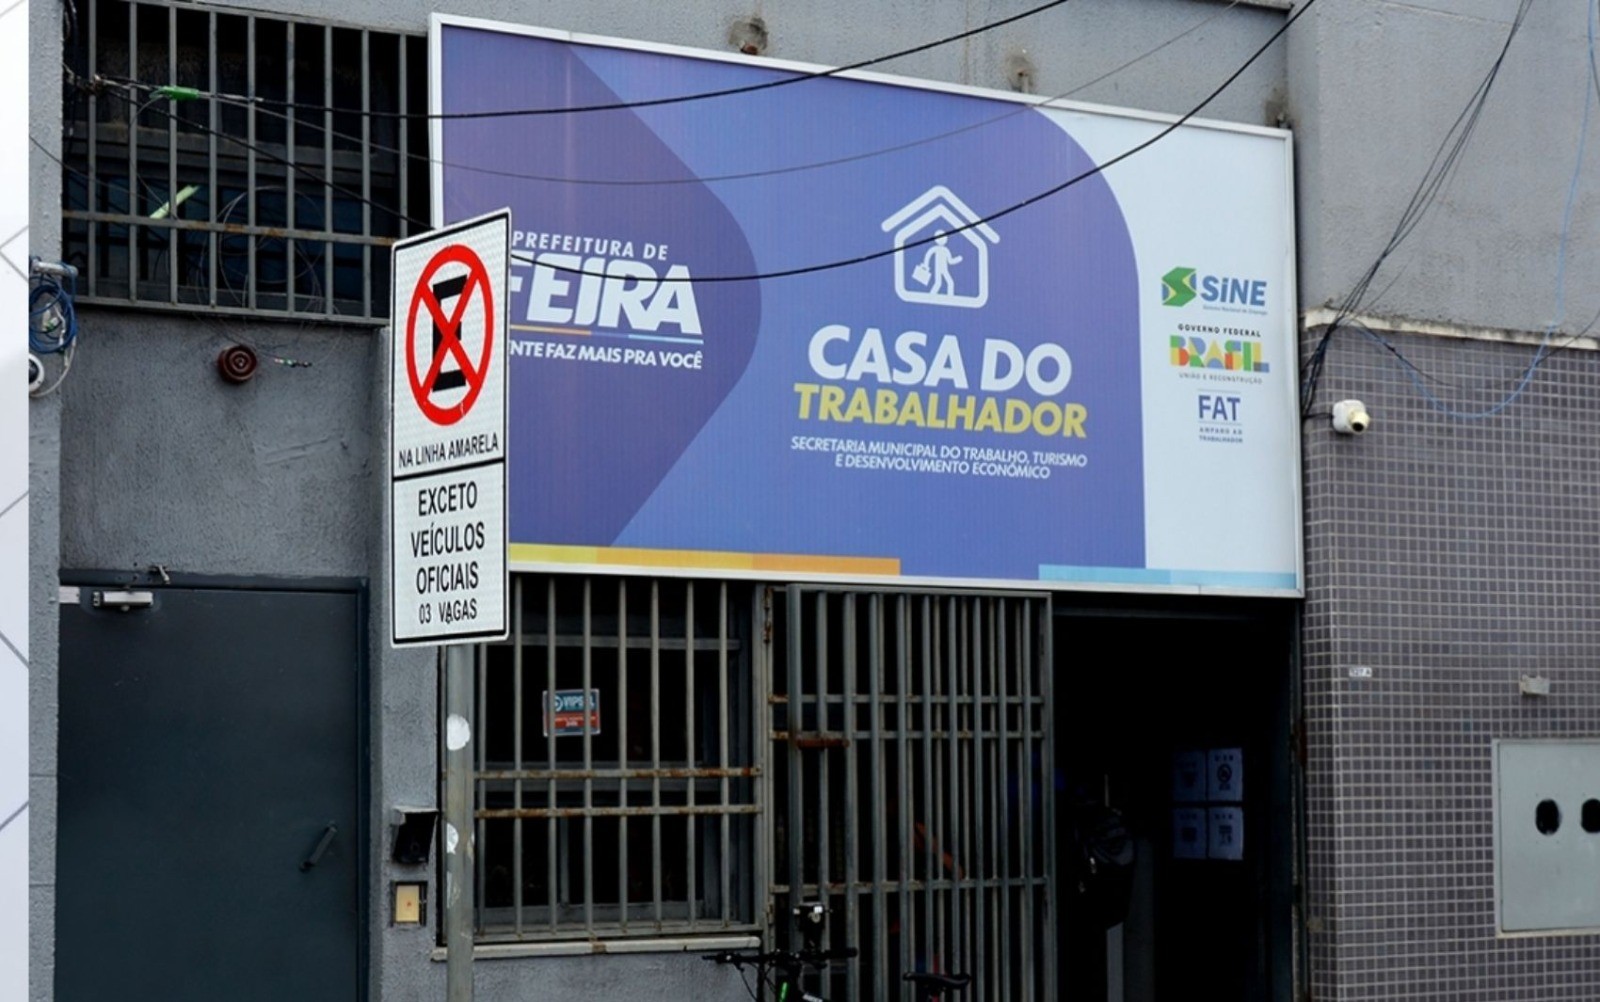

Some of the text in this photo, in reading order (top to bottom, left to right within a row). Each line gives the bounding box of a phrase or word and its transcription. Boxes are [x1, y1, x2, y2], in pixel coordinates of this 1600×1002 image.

[512, 230, 669, 260] PREFEITURA DE
[1177, 323, 1261, 338] GOVERNO FEDERAL
[544, 342, 578, 360] FAZ
[578, 344, 622, 363] MAIS
[623, 349, 657, 366] PRA
[659, 350, 704, 369] VOCÊ
[808, 324, 1073, 396] CASA DO
[1170, 335, 1270, 373] BRASIL
[793, 383, 1088, 438] TRABALHADOR
[1198, 395, 1241, 421] FAT
[398, 432, 499, 468] NA LINHA AMARELA
[790, 436, 1088, 468] SECRETARIA MUNICIPAL DO TRABALHO, TURISMO
[835, 453, 1051, 479] E DESENVOLVIMENTO ECONÔMICO
[418, 481, 478, 516] EXCETO
[411, 521, 485, 558] VEÍCULOS
[416, 561, 479, 595] OFICIAIS
[419, 598, 478, 625] 03 VAGAS
